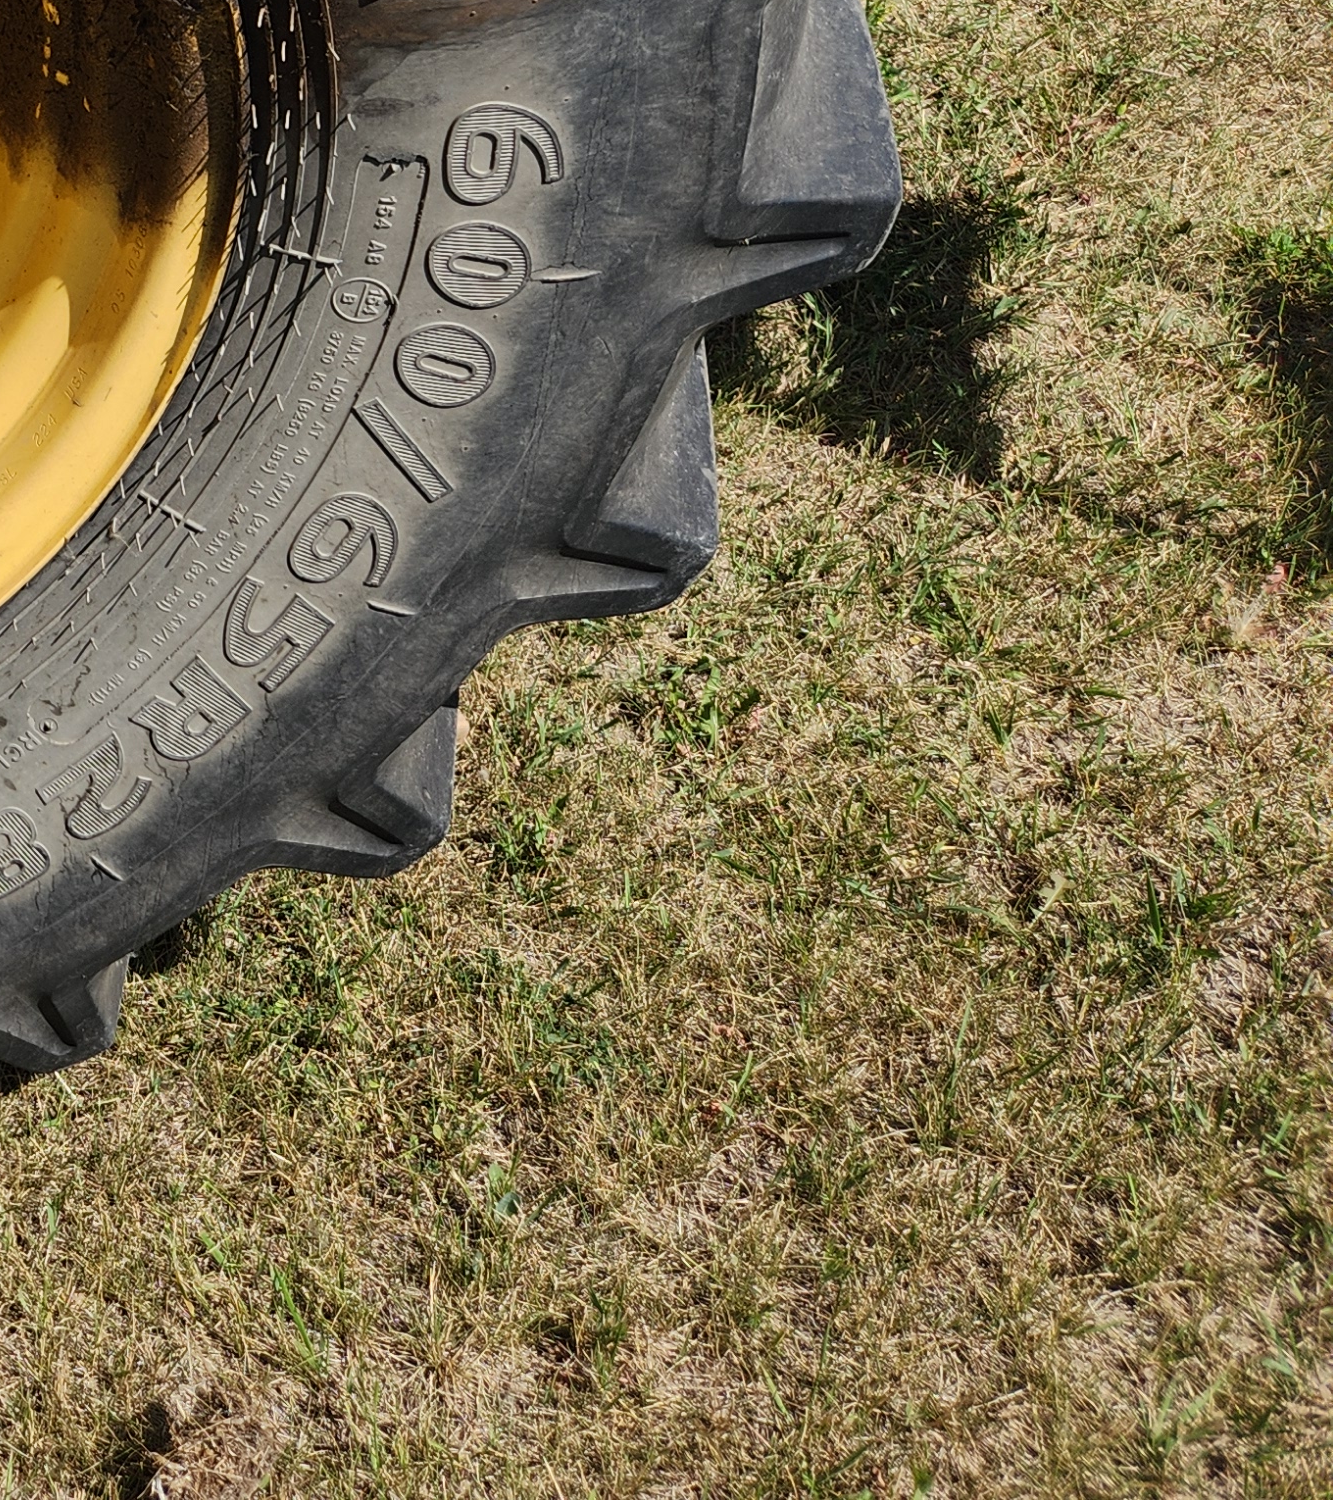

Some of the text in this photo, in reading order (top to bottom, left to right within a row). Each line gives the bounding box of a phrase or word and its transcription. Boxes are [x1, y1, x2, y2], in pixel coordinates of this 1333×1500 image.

[370, 194, 398, 232] 154
[305, 368, 327, 395] KG
[318, 374, 348, 417] LOAD
[28, 411, 59, 448] 224
[61, 365, 90, 400] USA
[306, 419, 326, 441] AT
[243, 477, 265, 499] AT
[262, 469, 296, 511] KM/H
[201, 527, 229, 558] BAR
[148, 610, 187, 649] KM/H
